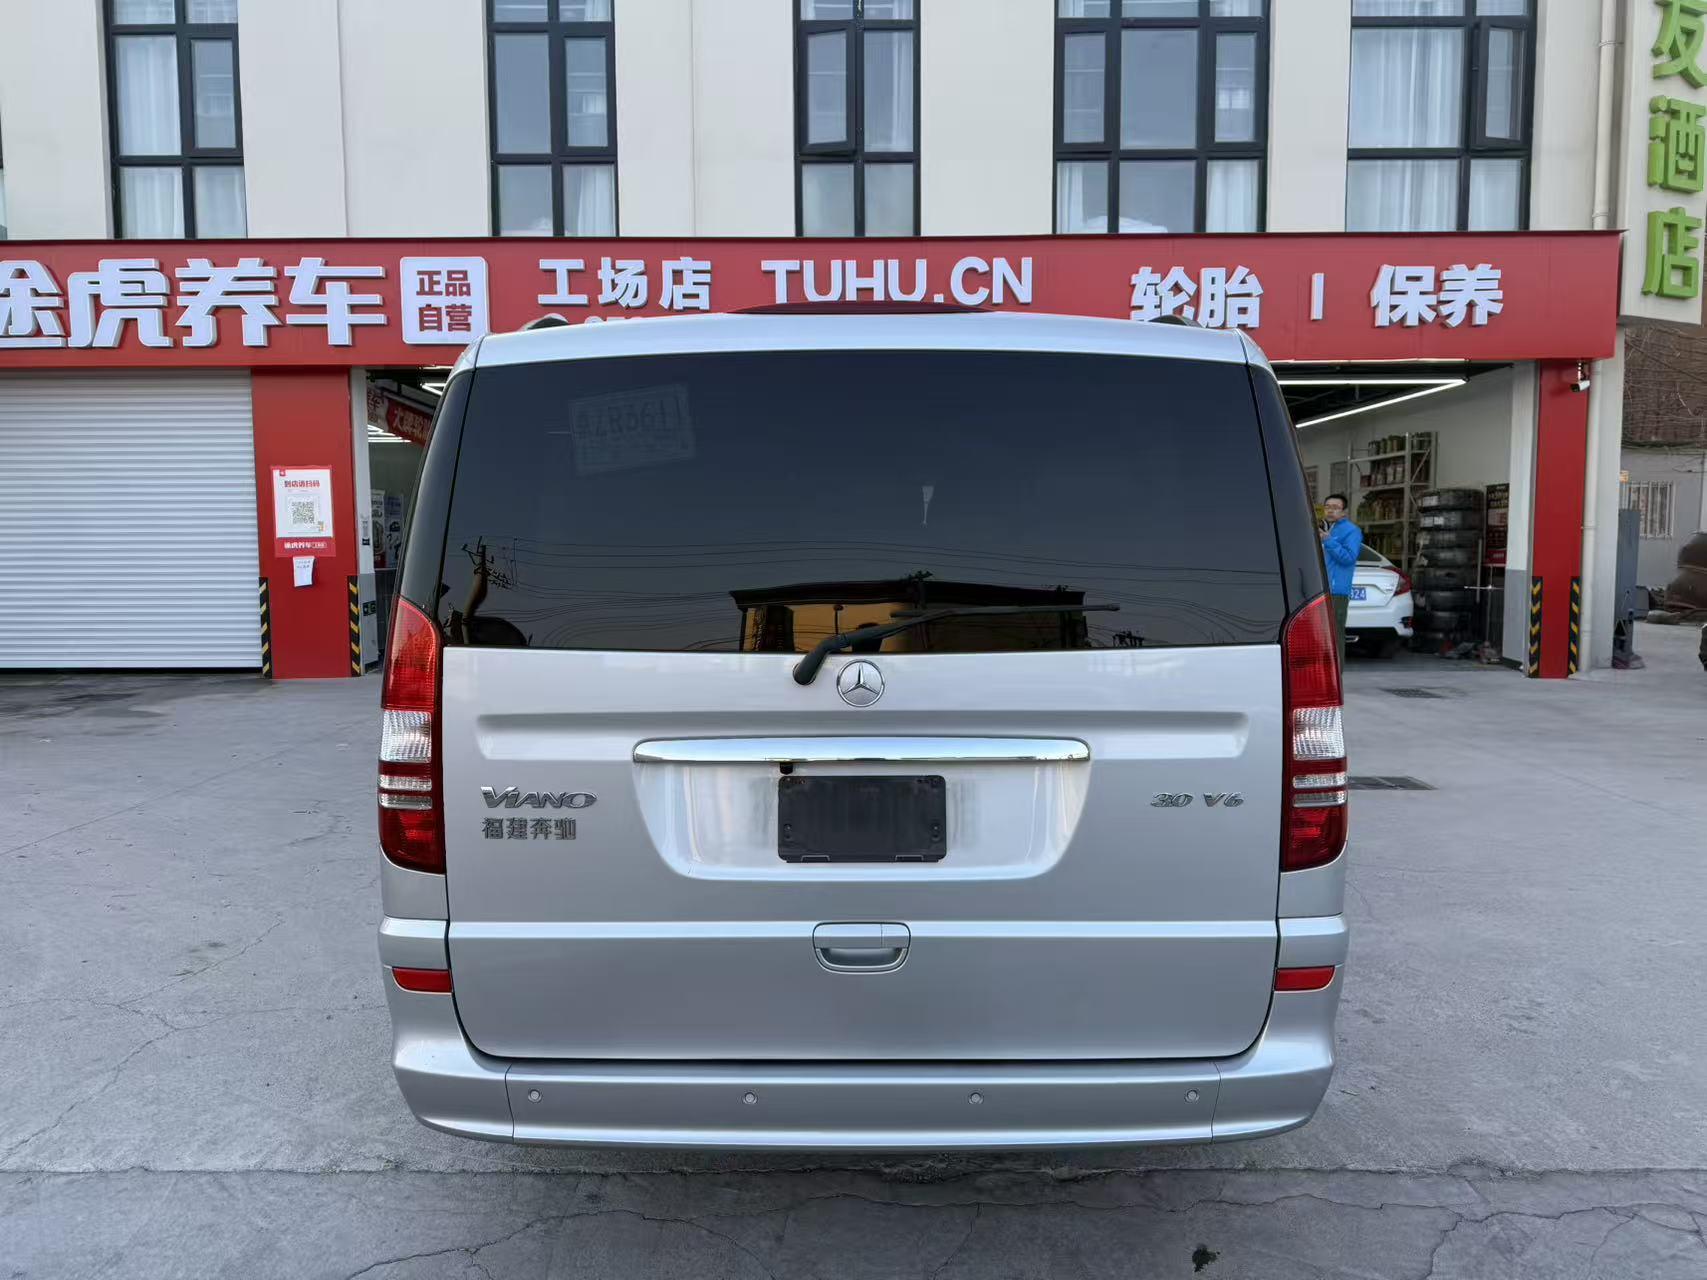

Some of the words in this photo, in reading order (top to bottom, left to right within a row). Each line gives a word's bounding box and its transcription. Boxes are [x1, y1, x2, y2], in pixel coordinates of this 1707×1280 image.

[416, 269, 471, 297] 正品
[537, 256, 712, 311] 工场店
[761, 256, 1033, 305] TUHU.CN
[1130, 265, 1264, 328] 轮胎
[1370, 263, 1505, 328] 保养
[417, 303, 473, 333] 自营
[480, 786, 597, 809] VIANO
[1203, 792, 1244, 808] V6
[482, 817, 577, 840] 福建奔驰
